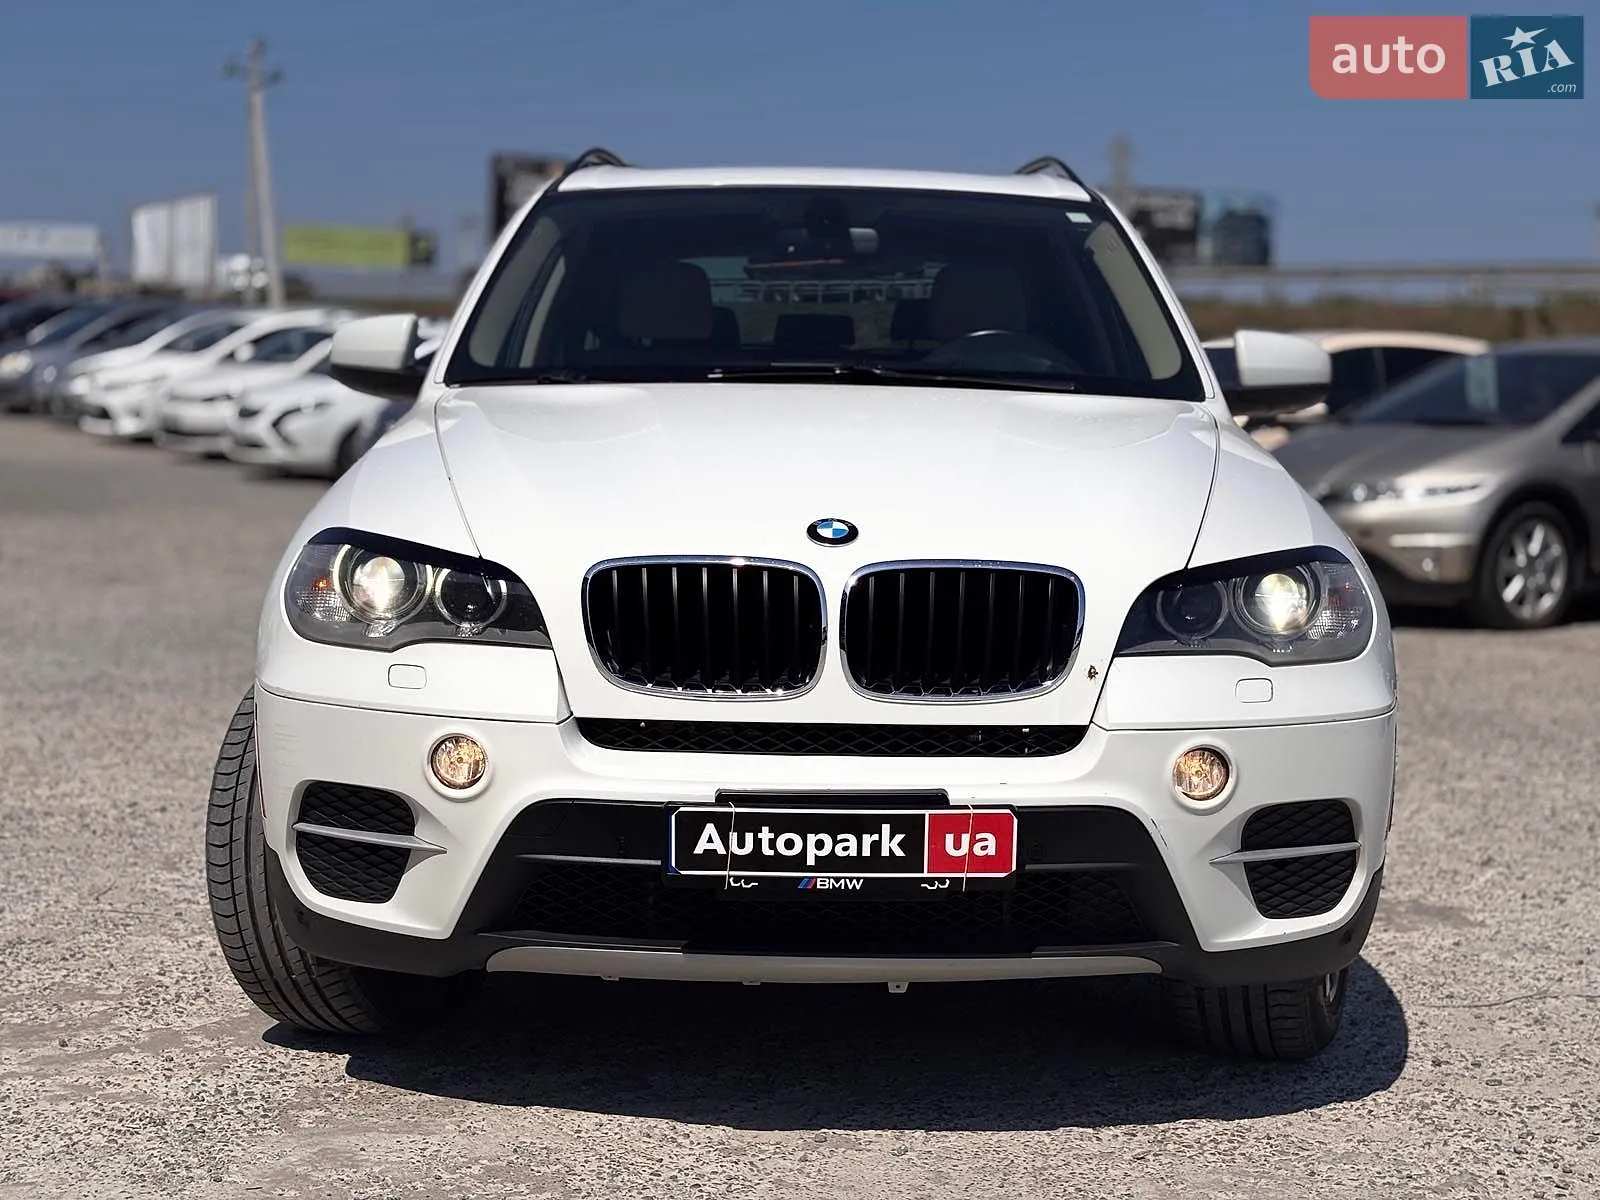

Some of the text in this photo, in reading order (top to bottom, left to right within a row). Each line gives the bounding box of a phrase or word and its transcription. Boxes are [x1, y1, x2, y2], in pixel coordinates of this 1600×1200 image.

[693, 822, 997, 866] Autopark ua
[816, 878, 864, 890] BMW
